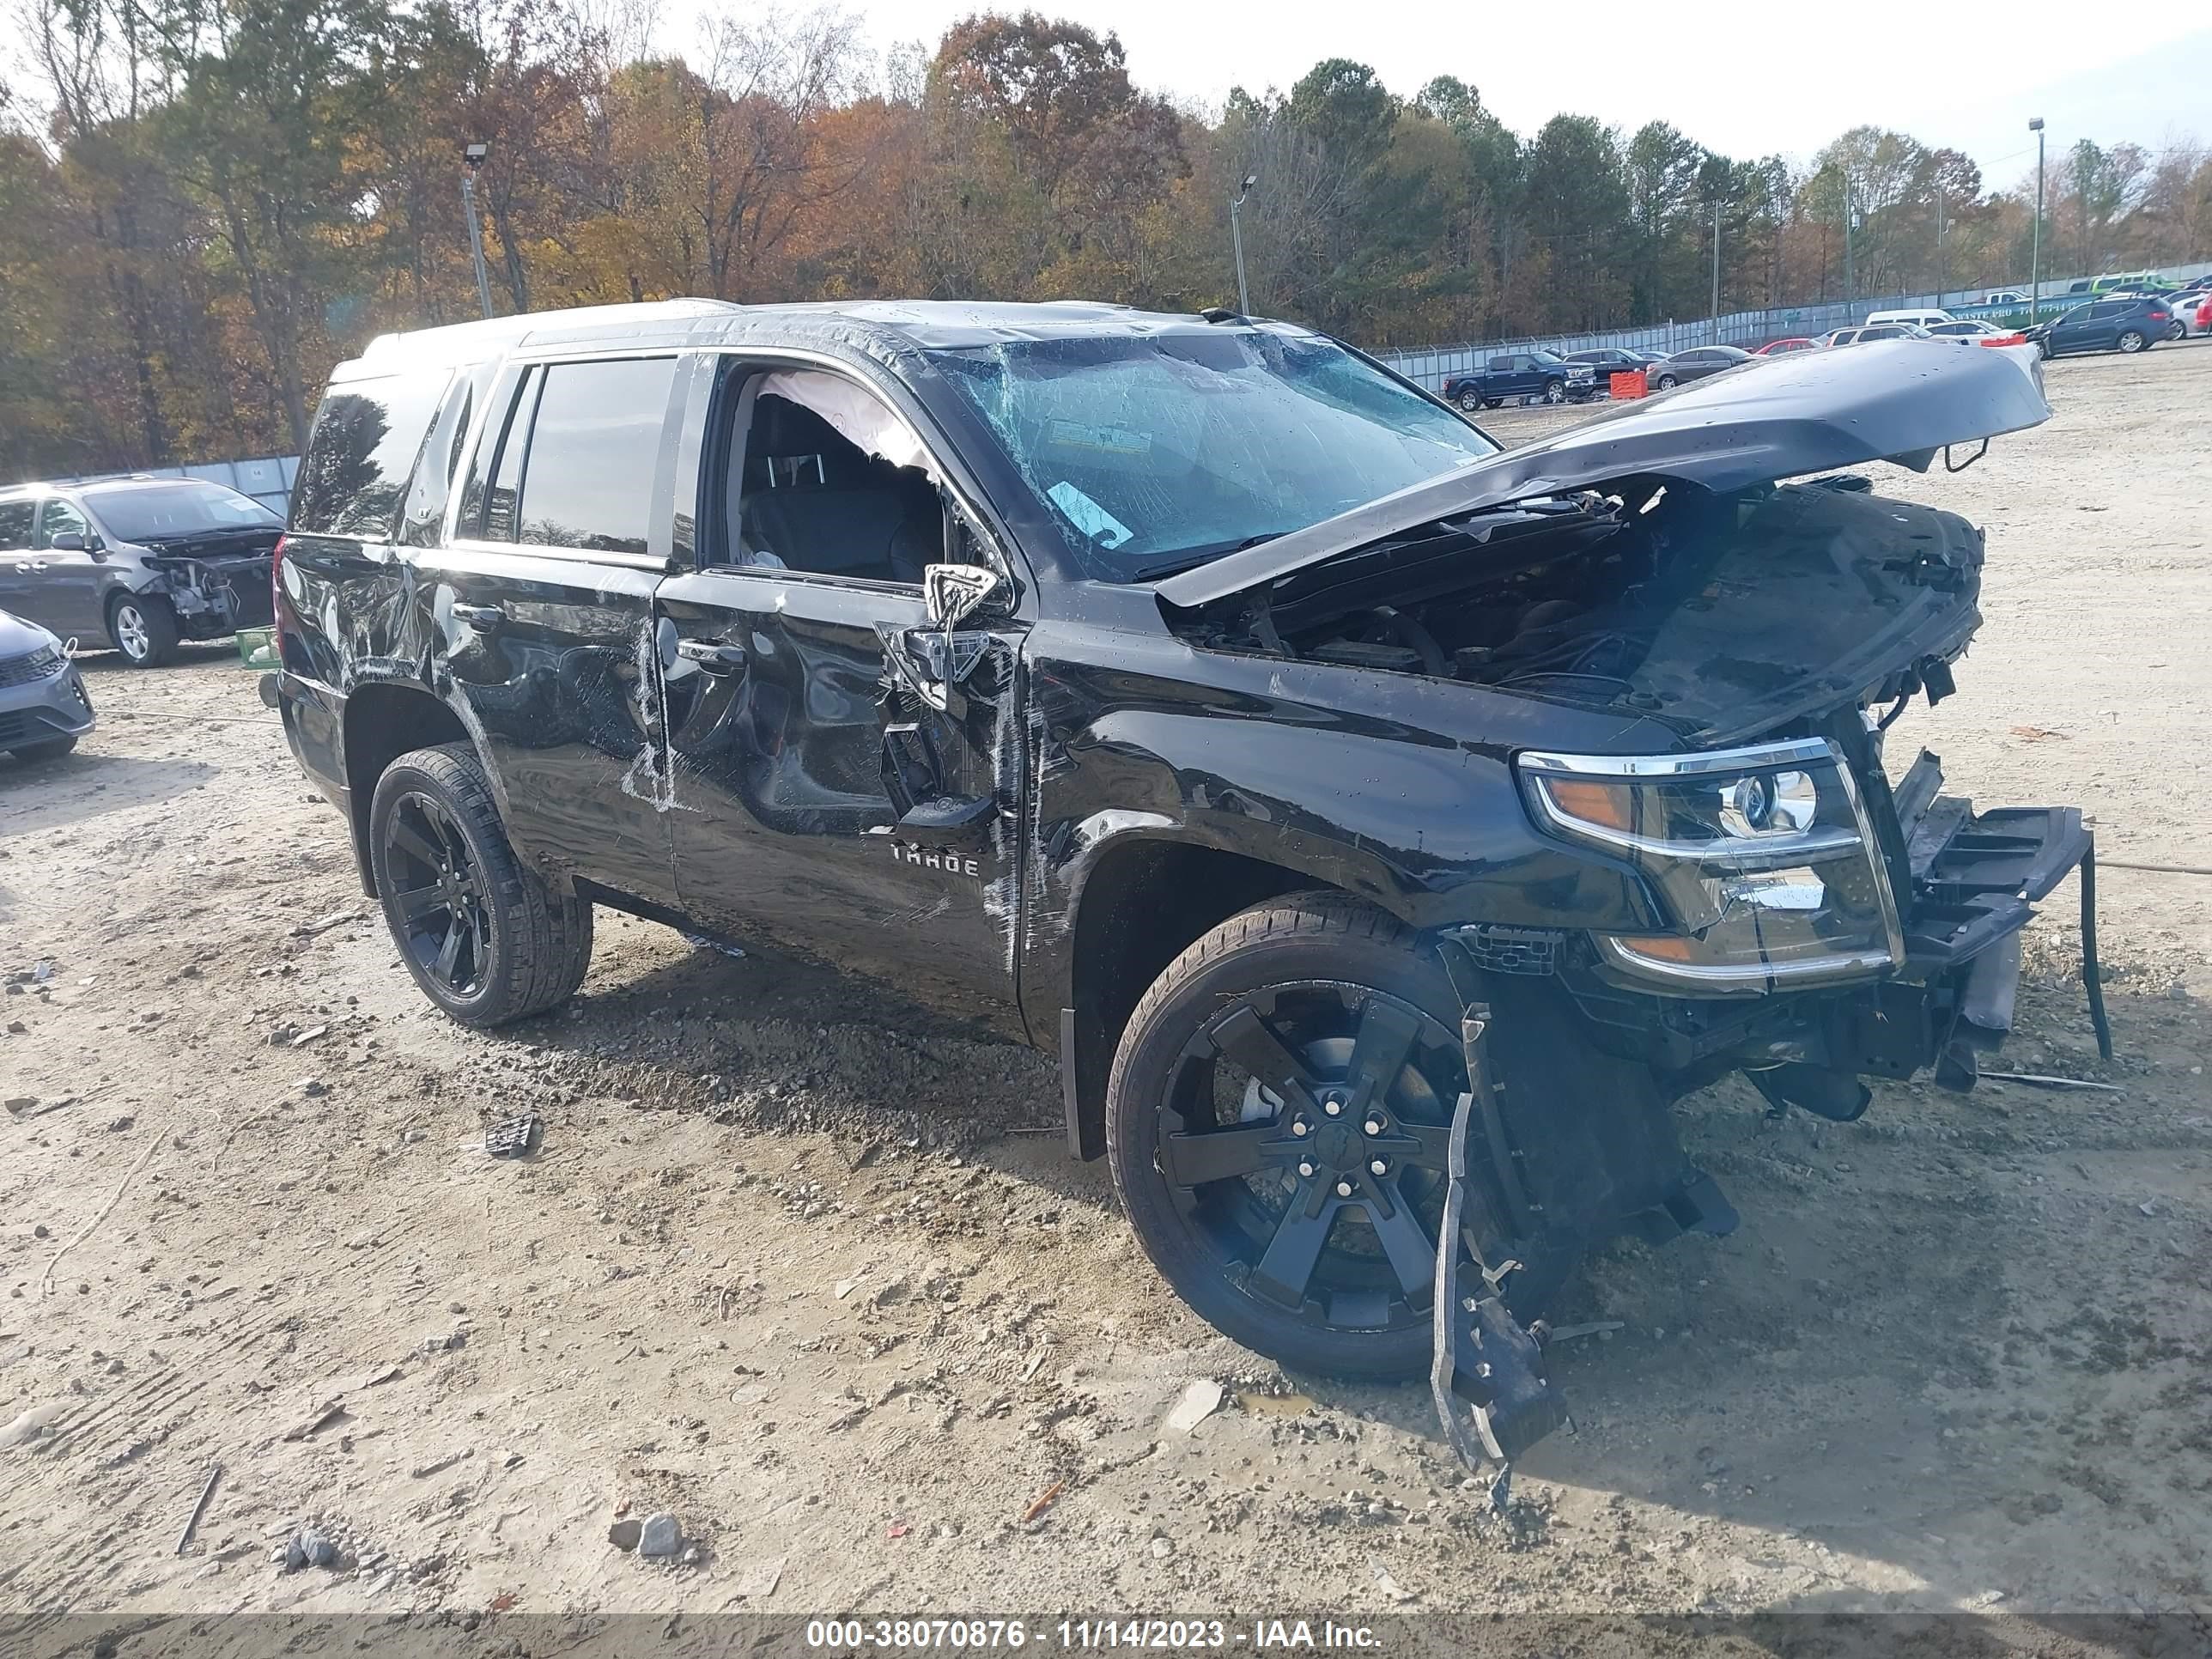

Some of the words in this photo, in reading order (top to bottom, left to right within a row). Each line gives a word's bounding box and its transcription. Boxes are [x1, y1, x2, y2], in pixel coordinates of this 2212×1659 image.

[1956, 310, 1990, 320] WASTE
[1991, 308, 2013, 318] PRO
[890, 842, 980, 878] TAHOE
